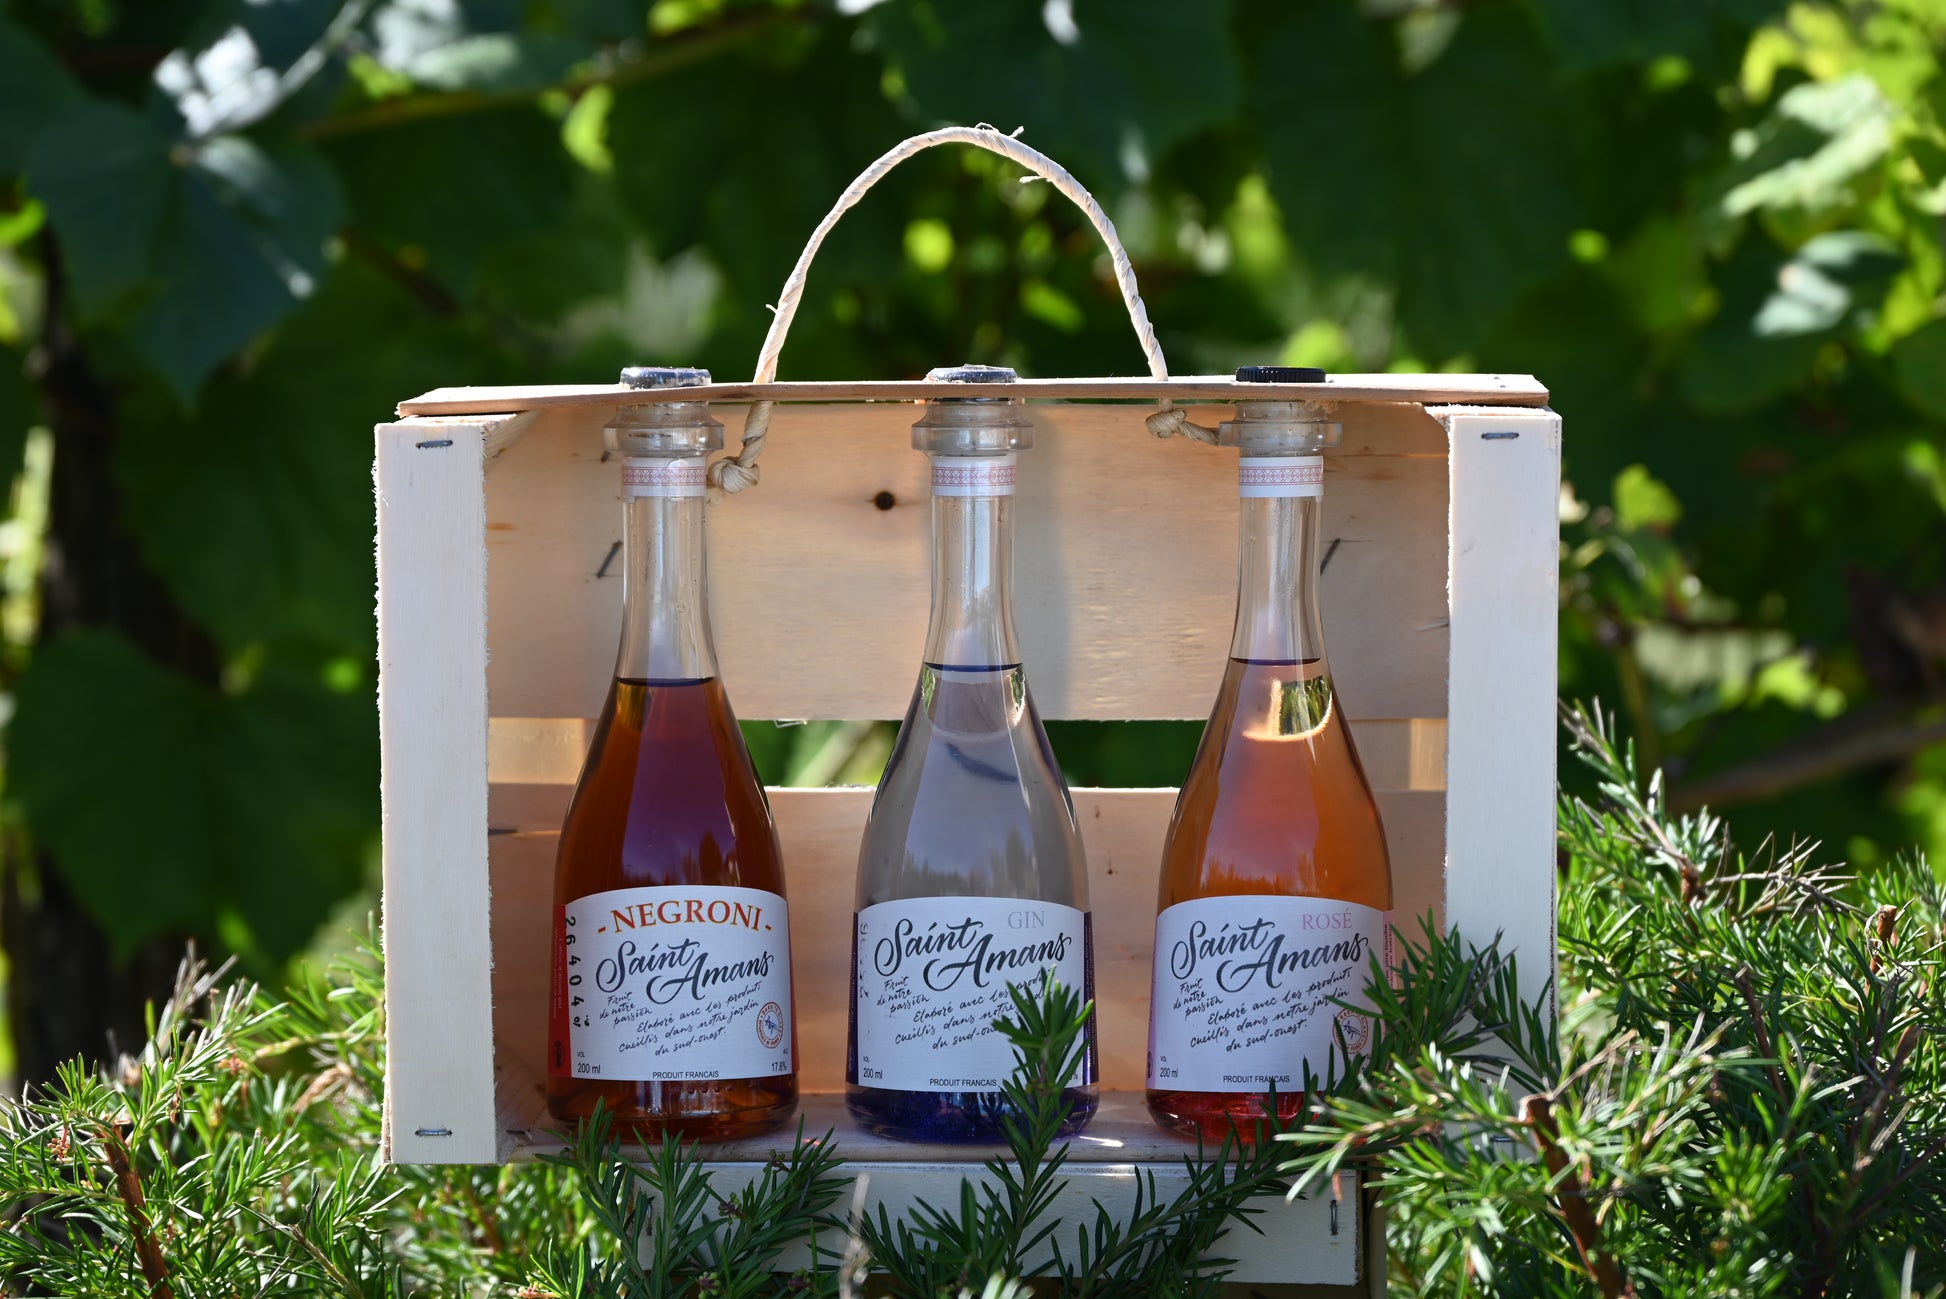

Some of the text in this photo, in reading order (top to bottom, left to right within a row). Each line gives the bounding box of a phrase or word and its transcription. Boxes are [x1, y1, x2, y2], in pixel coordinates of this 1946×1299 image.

[610, 900, 763, 933] NEGRONI
[1007, 911, 1046, 929] GIN
[1302, 907, 1352, 930] ROSÉ
[874, 917, 983, 977] Saint
[1171, 917, 1275, 980] Saint
[596, 938, 700, 993] Saint
[923, 932, 1072, 991] Amans
[1216, 932, 1368, 993] Amans
[646, 951, 774, 1004] Amans
[884, 976, 909, 991] Fruit
[1180, 978, 1203, 993] Fruit
[1252, 997, 1278, 1010] avec
[1282, 990, 1302, 1003] les
[1306, 966, 1353, 996] produits
[607, 992, 632, 1005] Fruit
[680, 1008, 701, 1020] avec
[706, 1002, 721, 1012] les
[726, 981, 763, 1006] produits
[877, 987, 912, 1006] de notre
[890, 994, 930, 1018] passion
[959, 996, 985, 1009] avec
[989, 989, 1008, 1004] les
[1173, 991, 1207, 1009] de notre
[600, 1002, 636, 1019] de notre
[614, 1007, 653, 1029] passion
[1185, 996, 1224, 1021] passion
[619, 999, 759, 1053] cueillis dans notre jardin
[895, 1002, 1015, 1044] cueillis dans notre
[1191, 1027, 1229, 1047] cueillis
[1237, 1016, 1268, 1032] dans
[1272, 1003, 1309, 1019] notre
[655, 1045, 669, 1056] du
[932, 1037, 948, 1050] du
[1226, 1039, 1241, 1052] du
[577, 1063, 601, 1074] 200 ml
[652, 1071, 719, 1079] PRODUIT FRANCAIS
[863, 1068, 883, 1080] 200 ml
[1160, 1067, 1178, 1078] 200 ml
